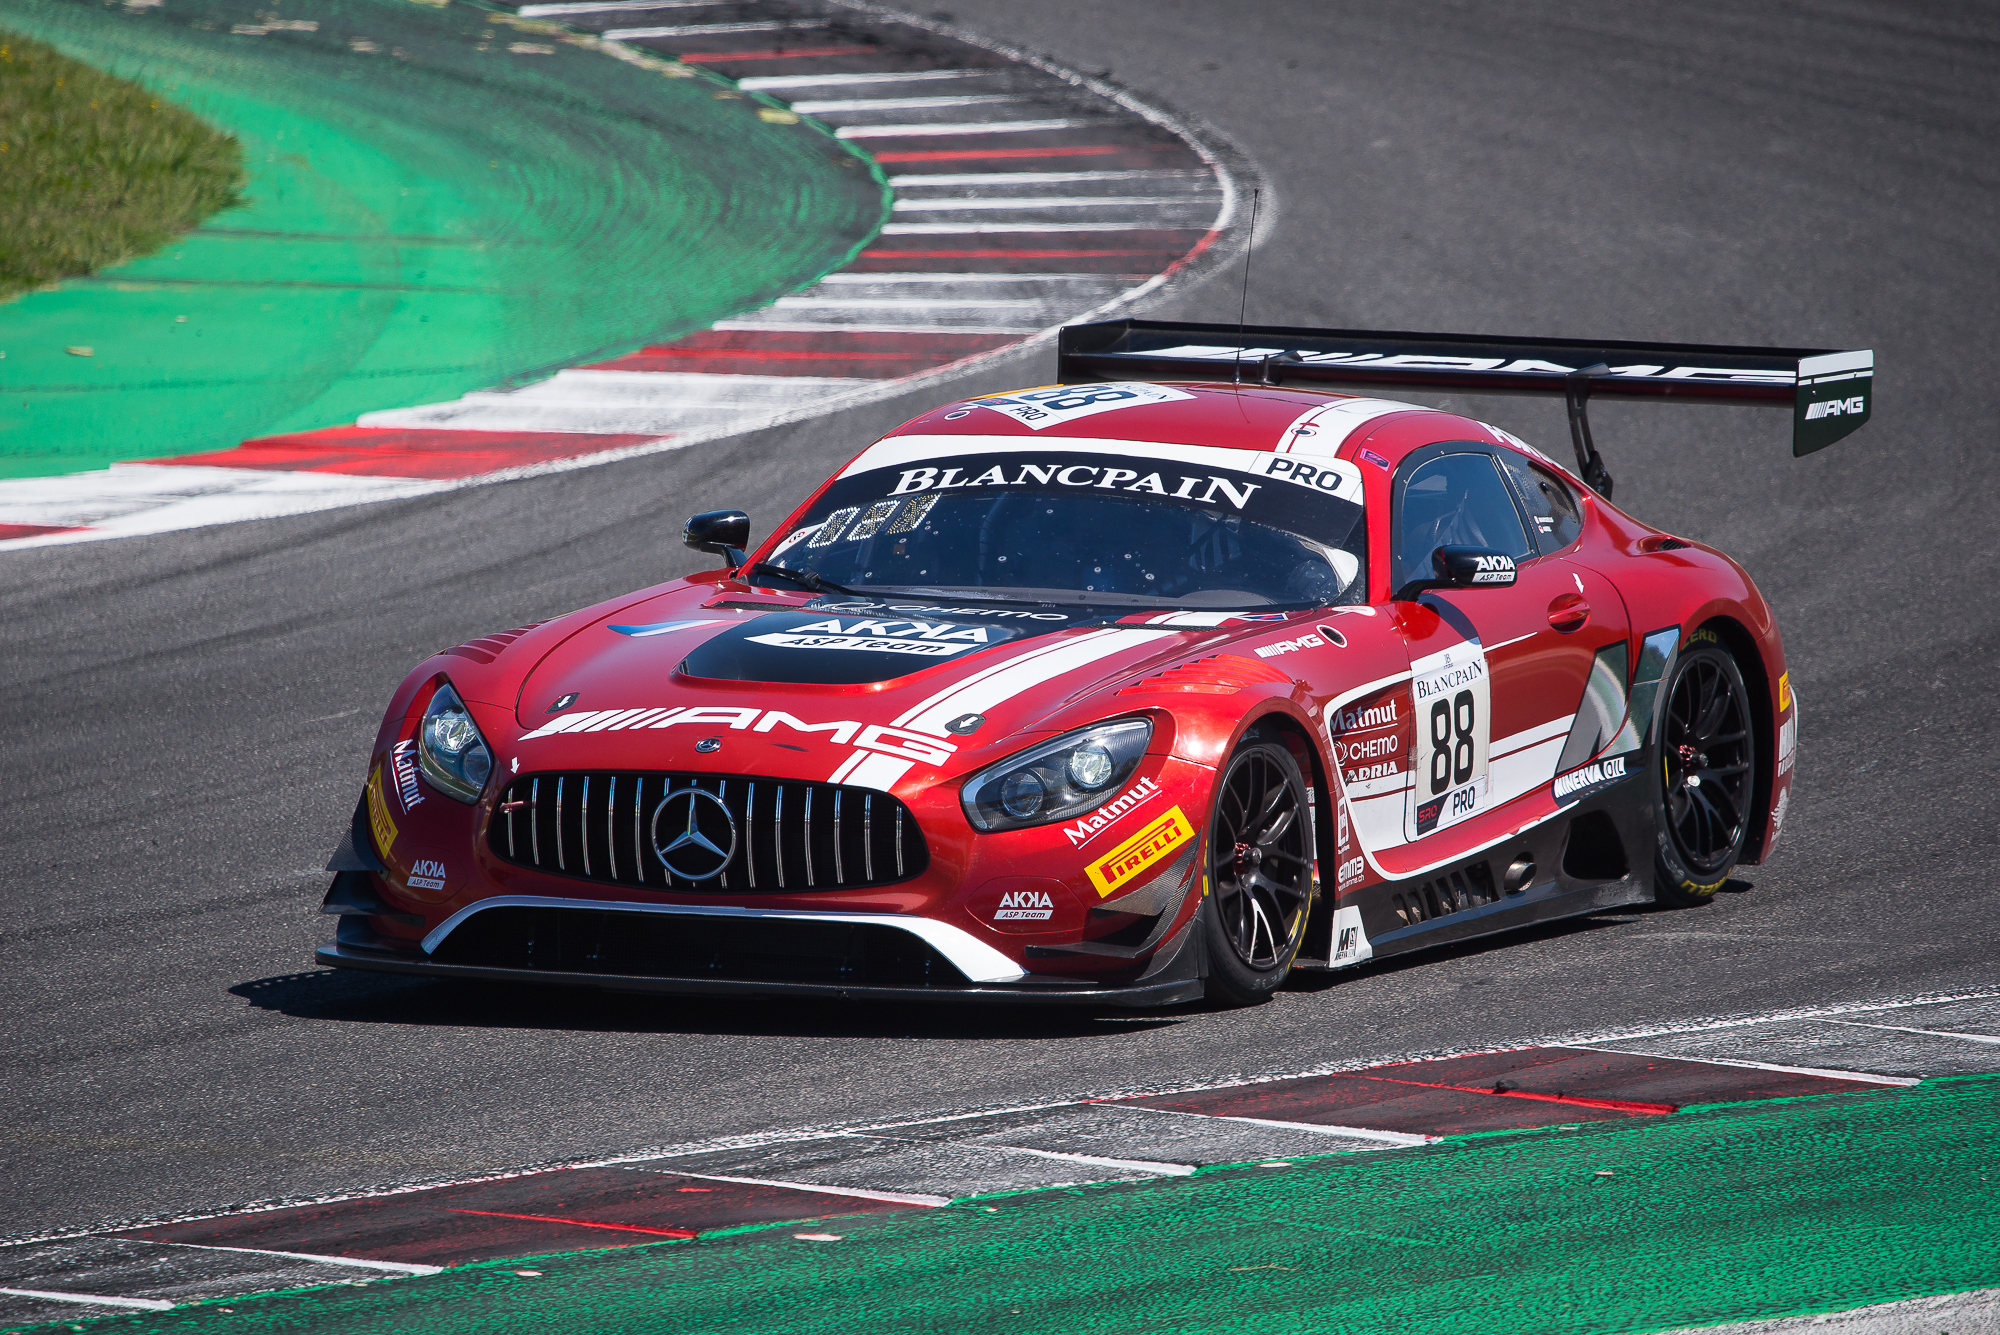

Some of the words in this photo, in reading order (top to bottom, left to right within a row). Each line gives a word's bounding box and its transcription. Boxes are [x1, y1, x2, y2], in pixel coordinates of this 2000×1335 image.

[1009, 405, 1048, 421] PRO
[887, 464, 1262, 510] BLANCPAIN
[1265, 457, 1344, 492] PRO
[1477, 555, 1516, 571] AKKA
[1480, 573, 1494, 581] ASP
[1496, 573, 1511, 581] Team
[889, 604, 1068, 620] CHEMO
[786, 618, 988, 643] AKKA
[781, 636, 848, 647] ASP
[850, 639, 945, 653] Team
[1417, 658, 1482, 699] BLANCPAIN
[1330, 699, 1398, 731] Matmut
[1349, 734, 1398, 760] CHEMO
[1430, 688, 1475, 796] 88
[394, 739, 425, 811] Matmut
[1345, 761, 1398, 782] ADRIA
[1553, 763, 1606, 799] MINERVA
[1605, 758, 1626, 779] OIL
[1063, 776, 1158, 845] Matmut
[1453, 785, 1475, 816] PRO
[1099, 817, 1181, 884] PIRELLI
[411, 859, 446, 878] AKKA
[412, 878, 424, 886] ASP
[424, 879, 440, 888] Team
[999, 892, 1054, 908] AKKA
[1002, 911, 1019, 919] ASP
[1021, 911, 1045, 919] Team
